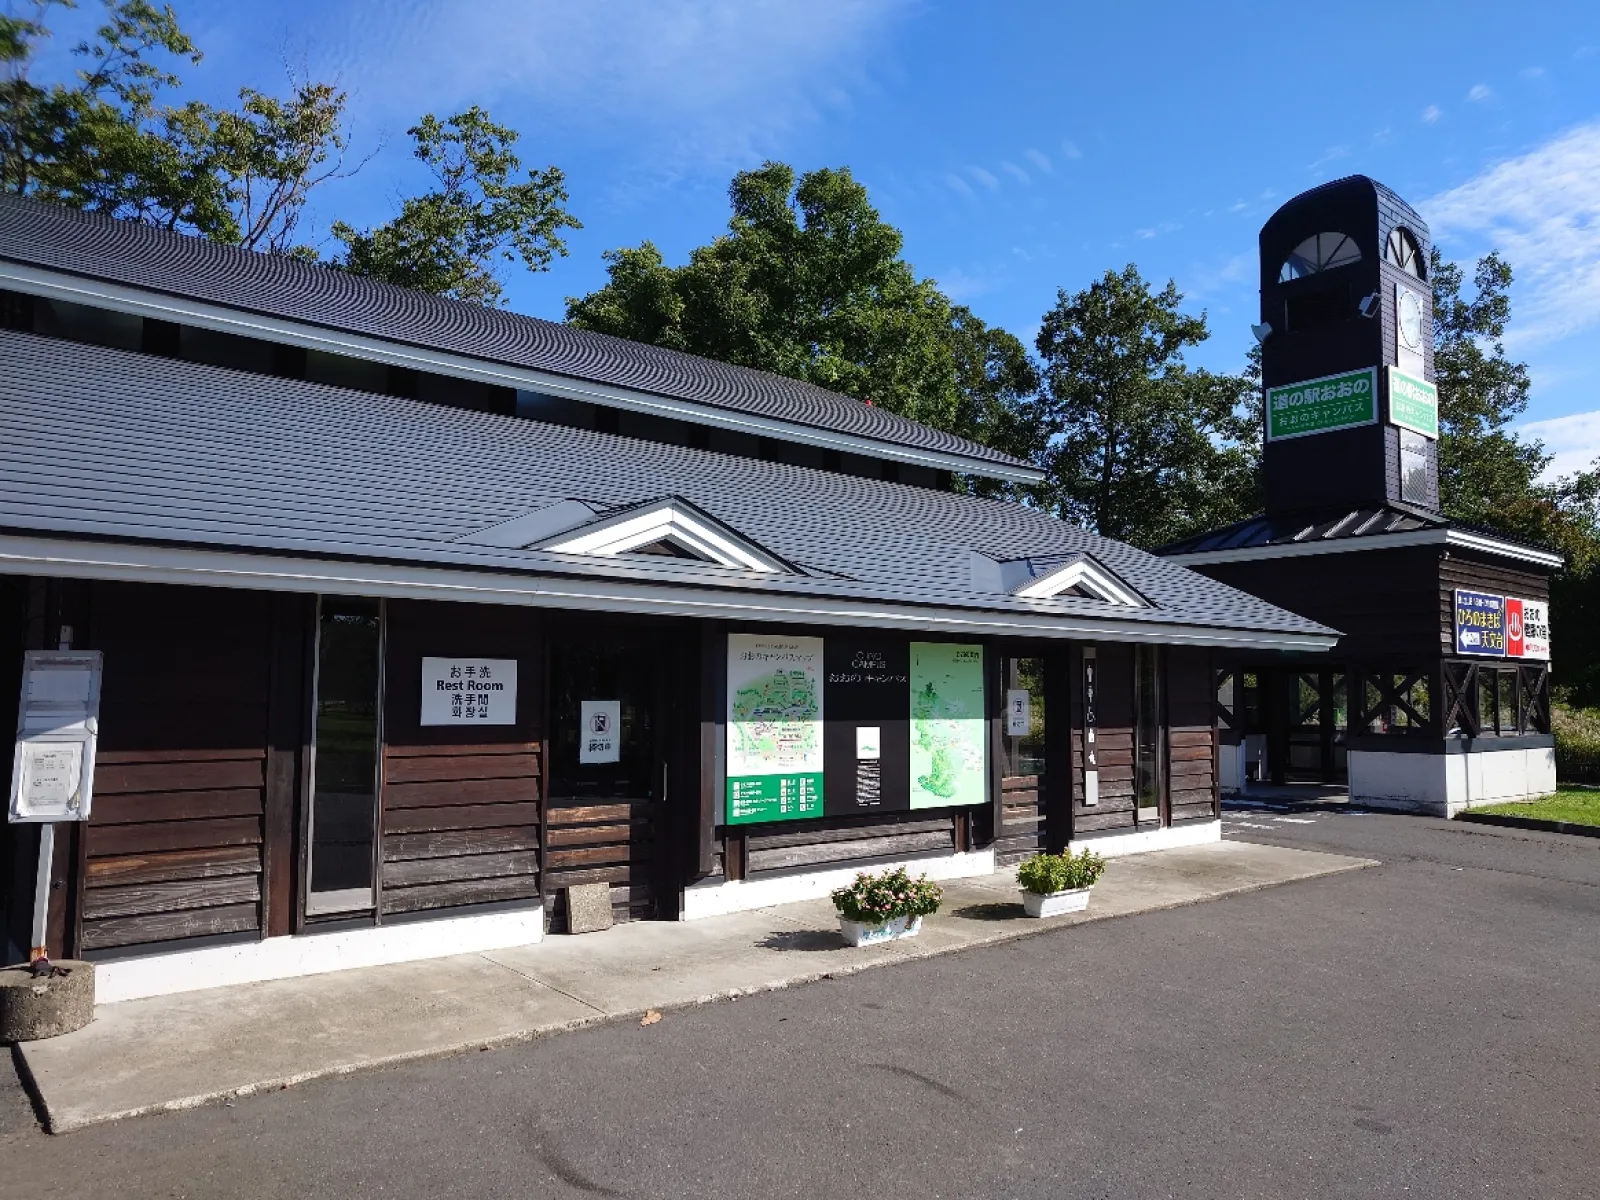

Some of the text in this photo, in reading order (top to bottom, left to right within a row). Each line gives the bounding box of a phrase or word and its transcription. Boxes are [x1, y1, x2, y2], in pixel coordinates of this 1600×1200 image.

[1273, 379, 1370, 410] 道の駅おおの
[1279, 402, 1365, 426] おおのキャンパス
[1458, 608, 1502, 629] ひろのまきば
[1481, 630, 1503, 650] 天文台
[450, 665, 491, 678] お手洗
[437, 680, 504, 691] Rest Room
[452, 694, 489, 706] 洗手間
